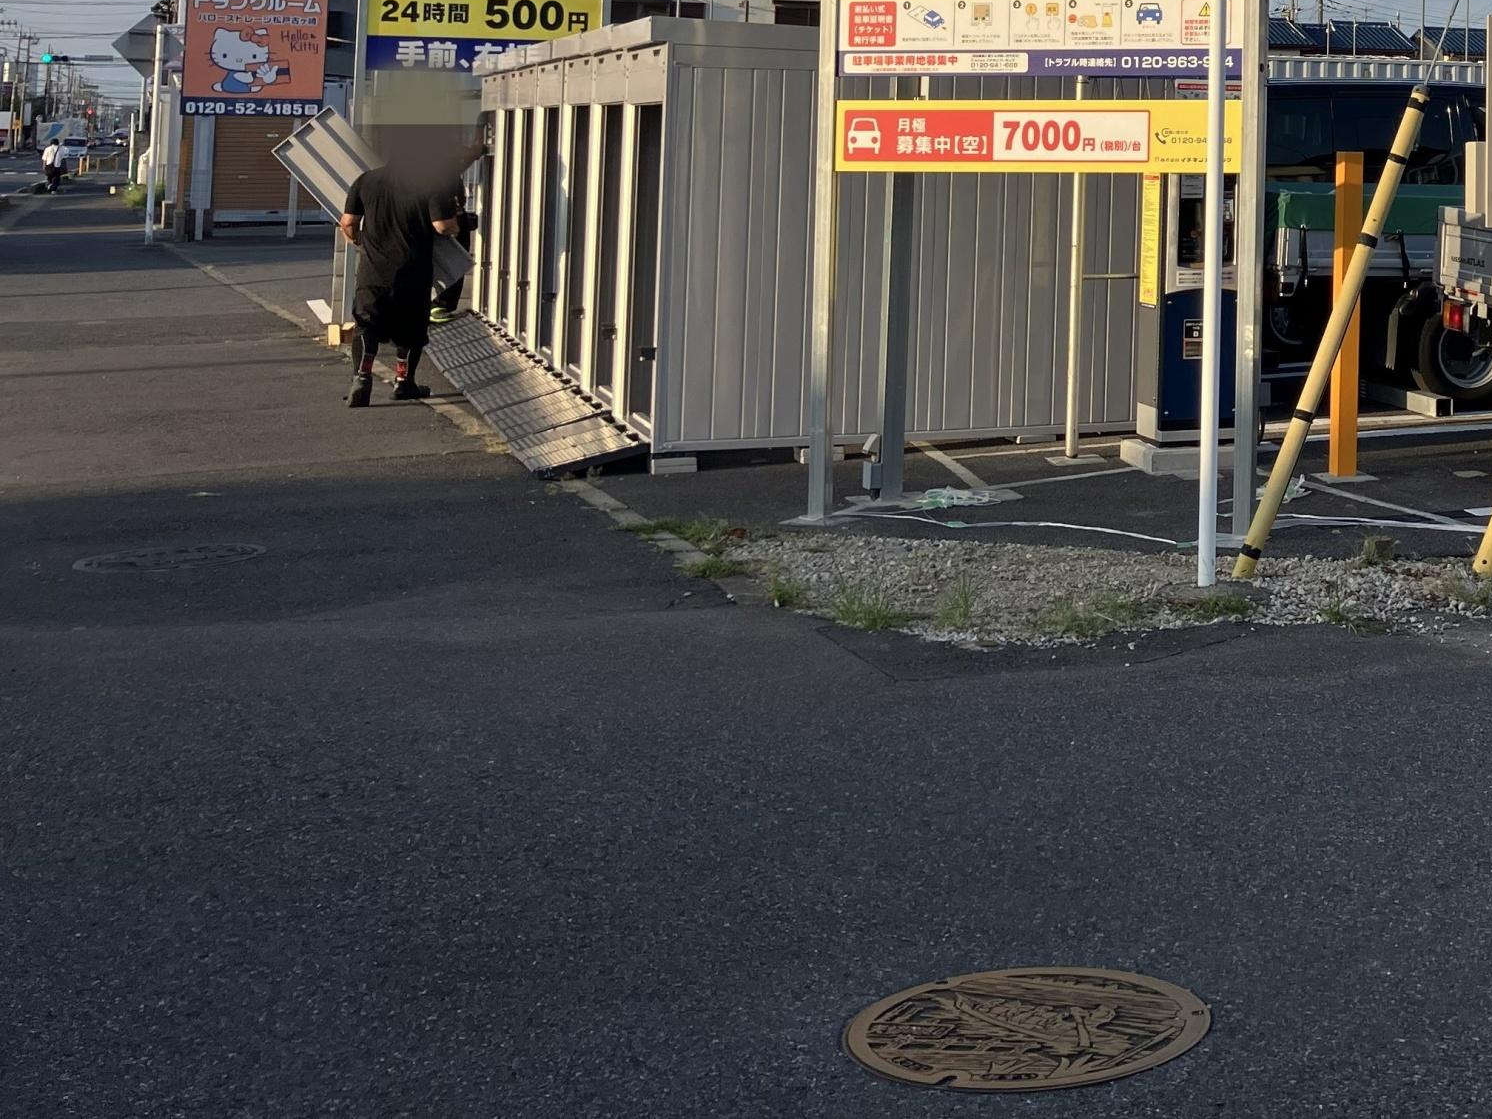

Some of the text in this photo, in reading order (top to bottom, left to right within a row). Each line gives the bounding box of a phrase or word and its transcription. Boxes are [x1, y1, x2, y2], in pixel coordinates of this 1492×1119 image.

[381, 0, 589, 32] 24時間 500円
[281, 30, 310, 41] Hello
[291, 41, 319, 54] Kitty
[1121, 56, 1234, 68] 0120-963-94
[185, 101, 302, 114] 0120-52-4185
[897, 117, 927, 133] 月極
[1002, 120, 1096, 152] 7000円
